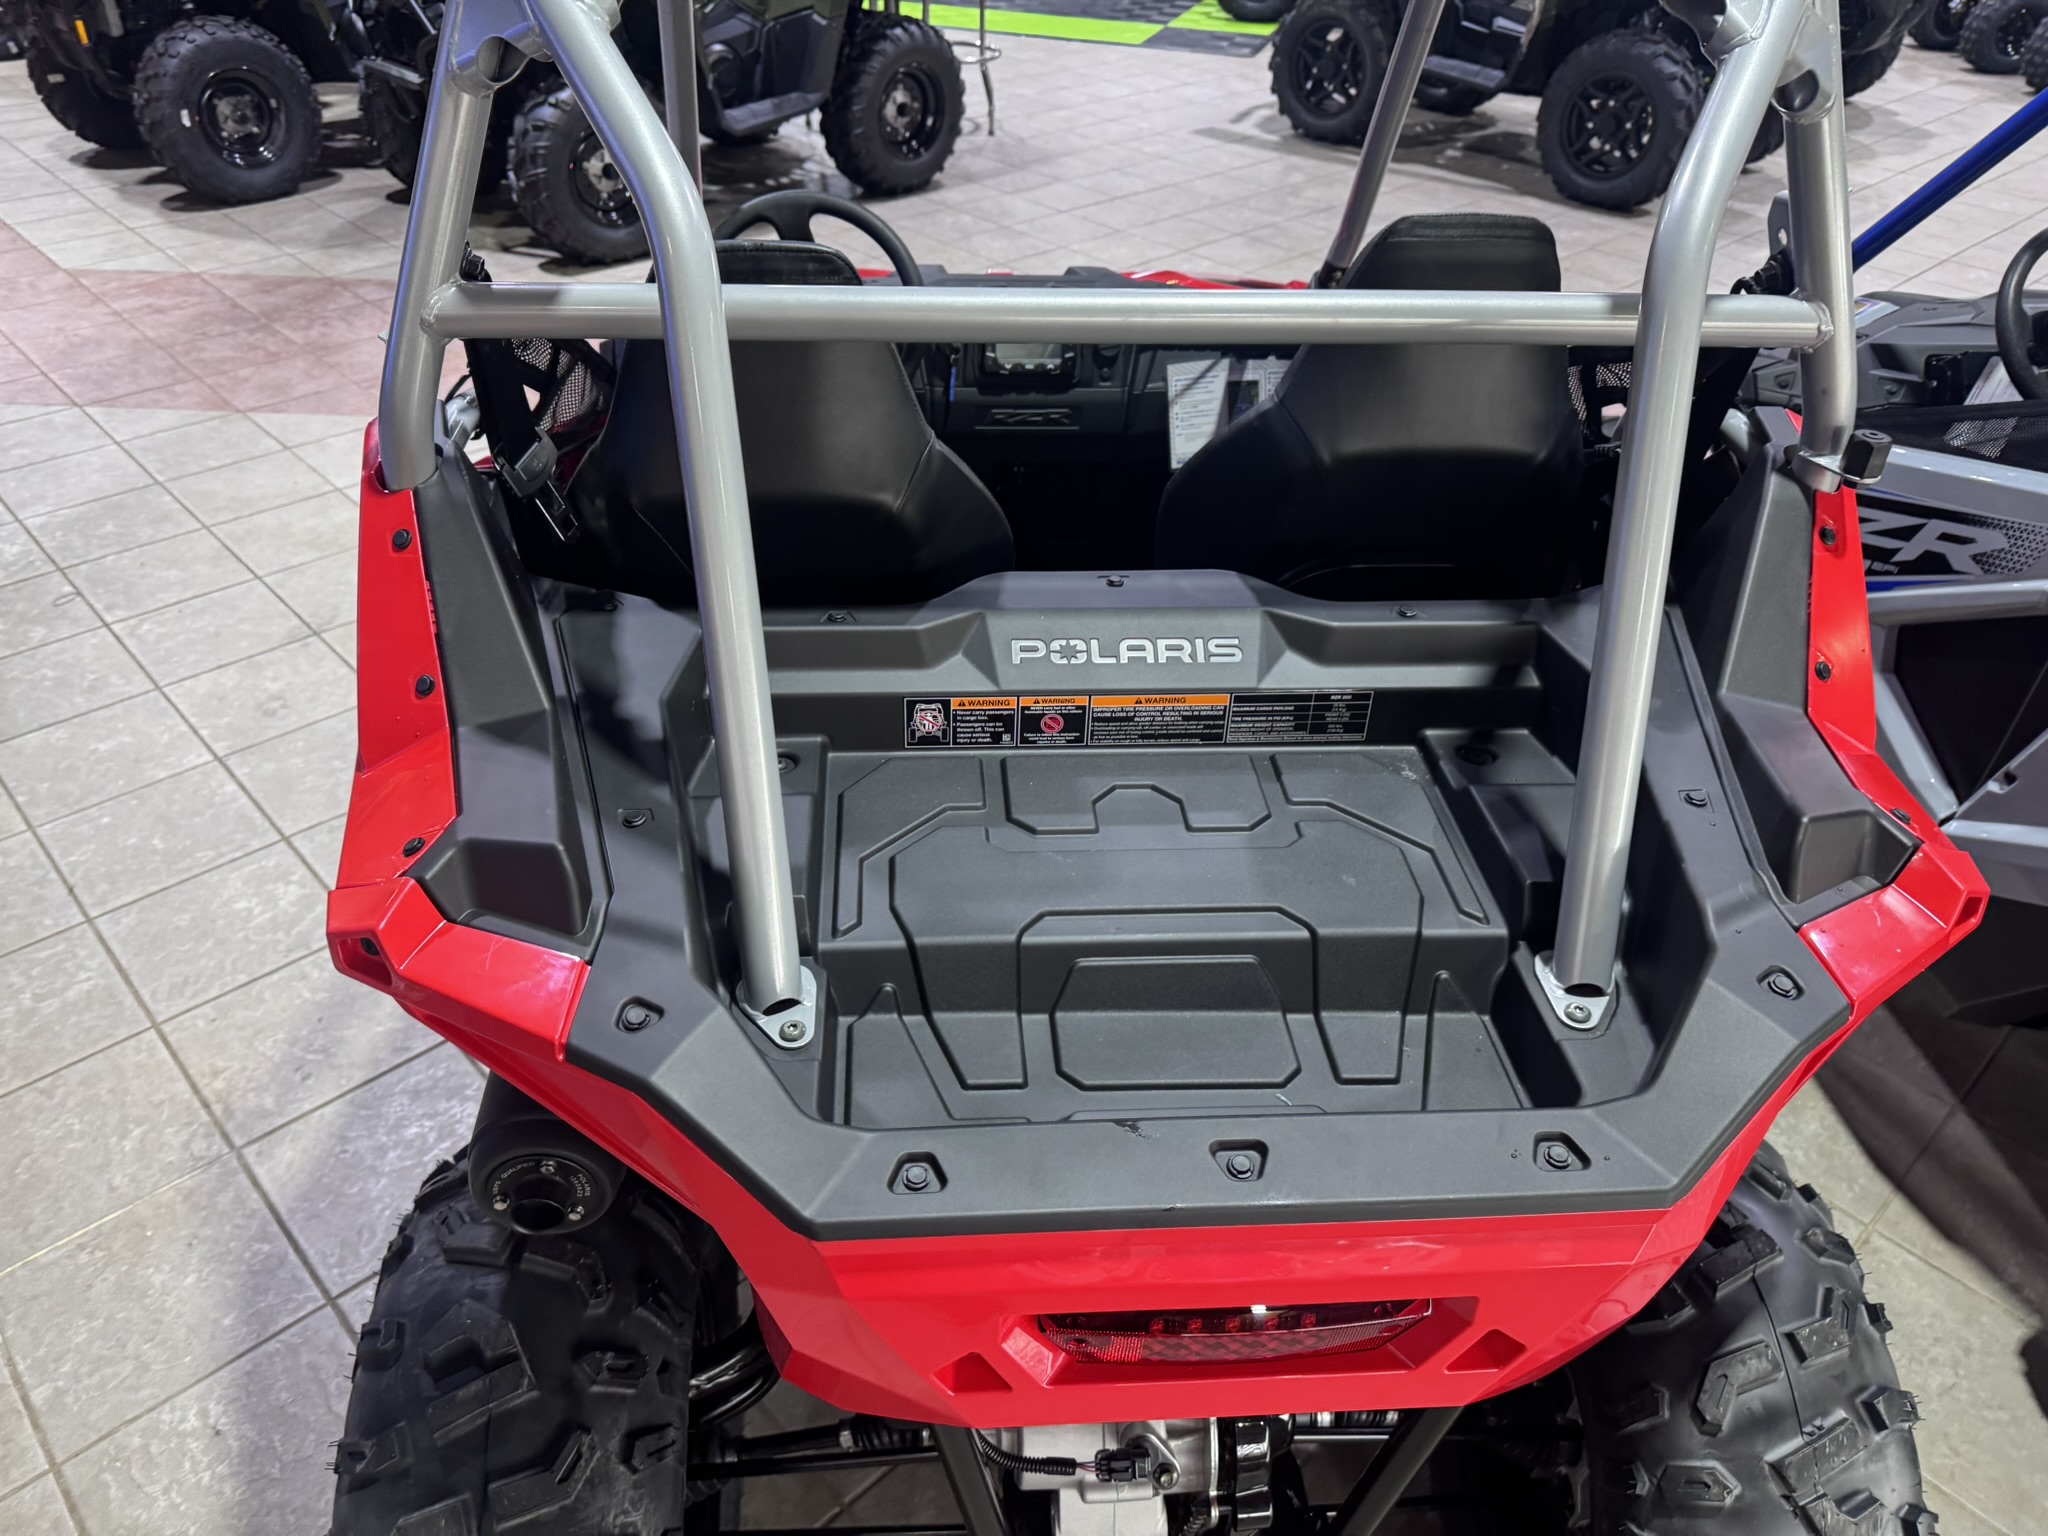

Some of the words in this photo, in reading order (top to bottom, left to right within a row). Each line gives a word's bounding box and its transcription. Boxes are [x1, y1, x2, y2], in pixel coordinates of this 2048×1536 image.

[1856, 505, 2011, 576] ZR
[1011, 637, 1244, 664] POLARIS
[501, 1162, 535, 1178] QUALIFIED
